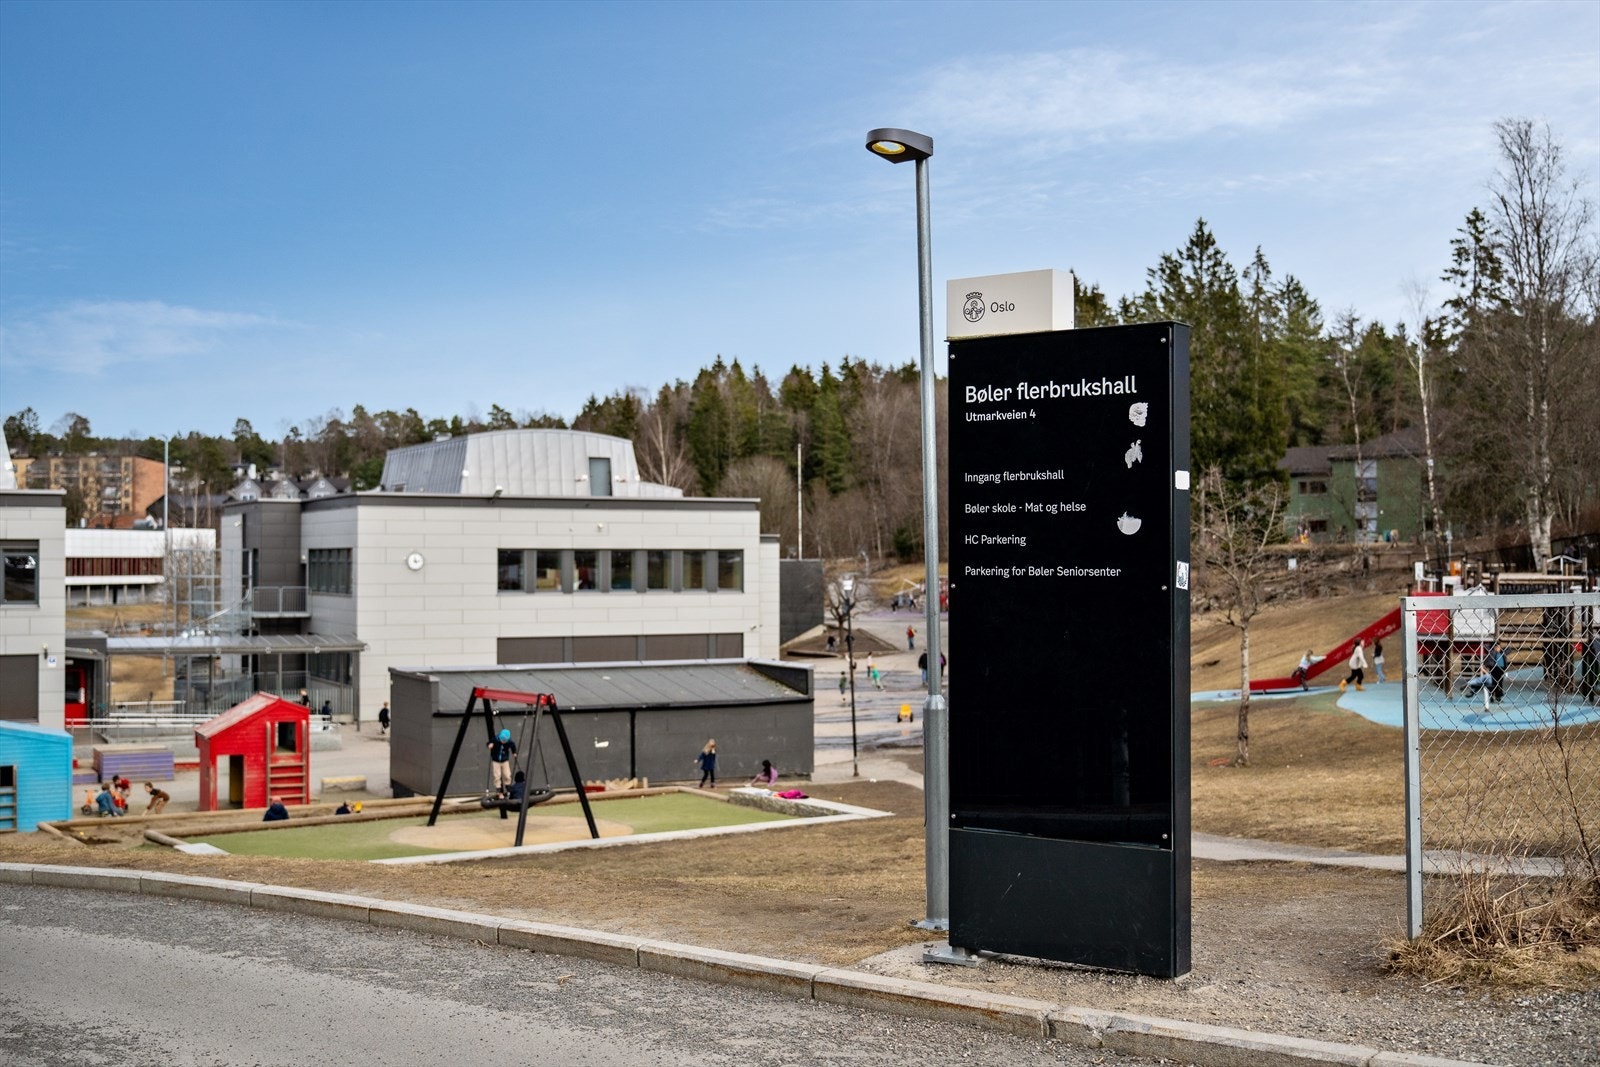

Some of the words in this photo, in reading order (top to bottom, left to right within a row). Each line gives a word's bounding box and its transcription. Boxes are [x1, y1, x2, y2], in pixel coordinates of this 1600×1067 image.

[990, 300, 1016, 314] Oslo
[966, 384, 1012, 404] Bøler
[1016, 375, 1137, 400] flerbrukshall
[966, 410, 1028, 422] Utmarkveien
[1030, 408, 1036, 418] 4
[964, 472, 1002, 484] Inngang
[1002, 470, 1064, 482] flerbrukshall
[964, 504, 990, 514] Bøler
[992, 502, 1016, 514] skole
[1024, 502, 1044, 512] Mat
[1046, 504, 1058, 514] og
[1060, 502, 1086, 512] helse
[964, 534, 978, 544] HC
[982, 534, 1026, 546] Parkering
[964, 566, 1010, 578] Parkering
[1012, 566, 1026, 576] for
[1028, 566, 1054, 576] Bøler
[1056, 566, 1122, 576] Seniorsenter
